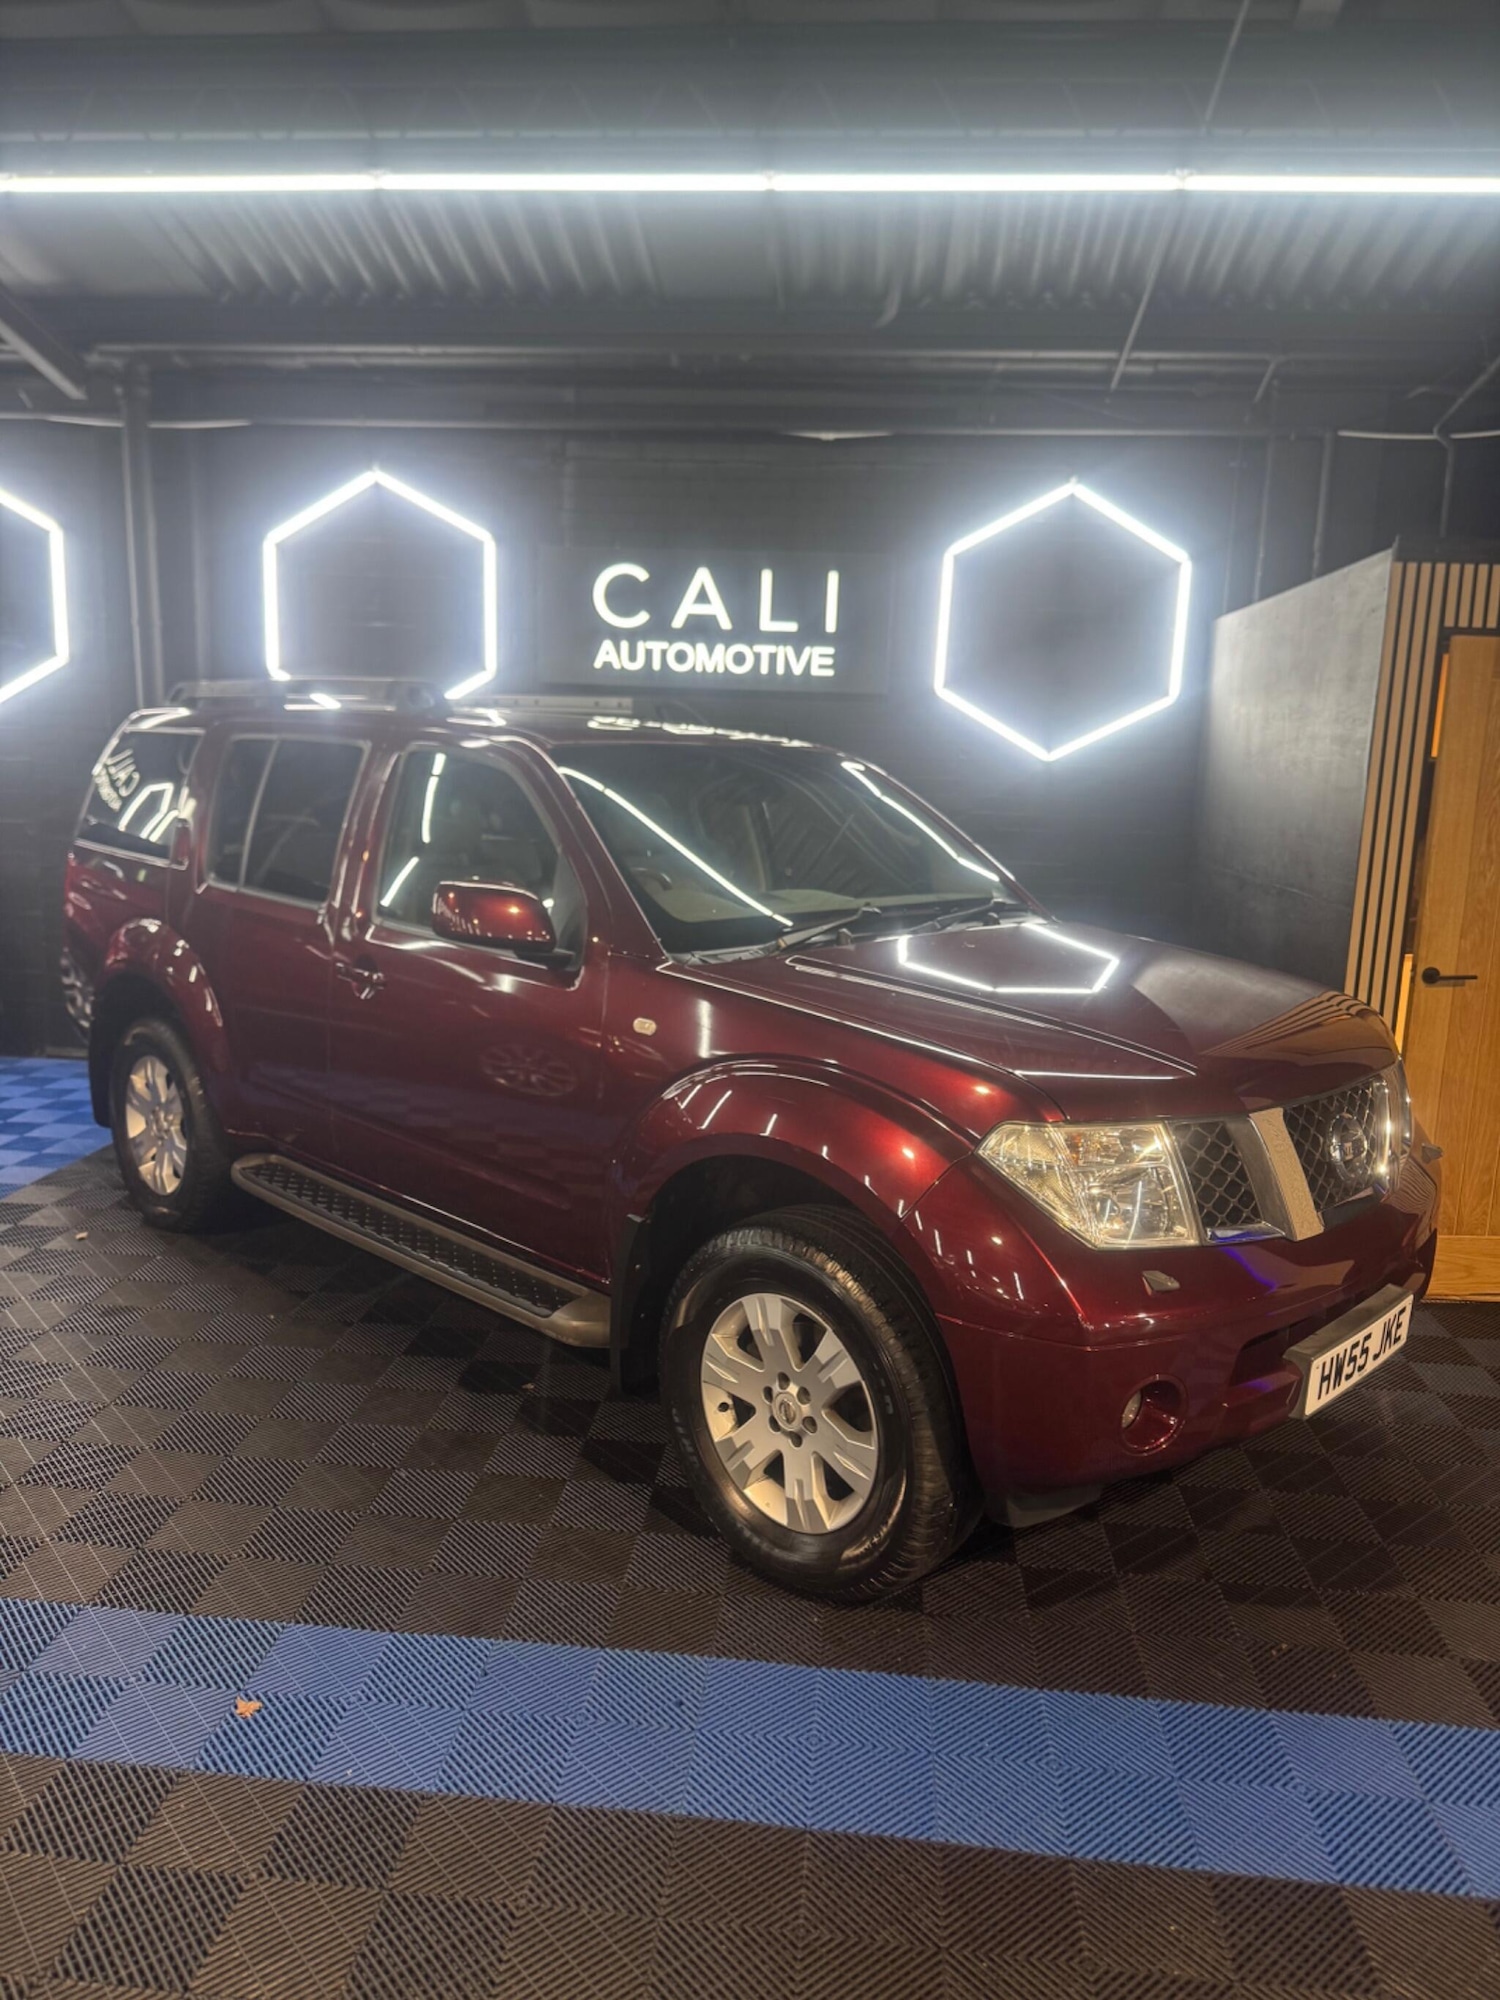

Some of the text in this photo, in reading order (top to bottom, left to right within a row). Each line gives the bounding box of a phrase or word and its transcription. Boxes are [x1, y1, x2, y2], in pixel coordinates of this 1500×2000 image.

[592, 562, 839, 633] CALI
[593, 639, 836, 677] AUTOMOTIVE
[1317, 1306, 1407, 1400] HW55 JKE
